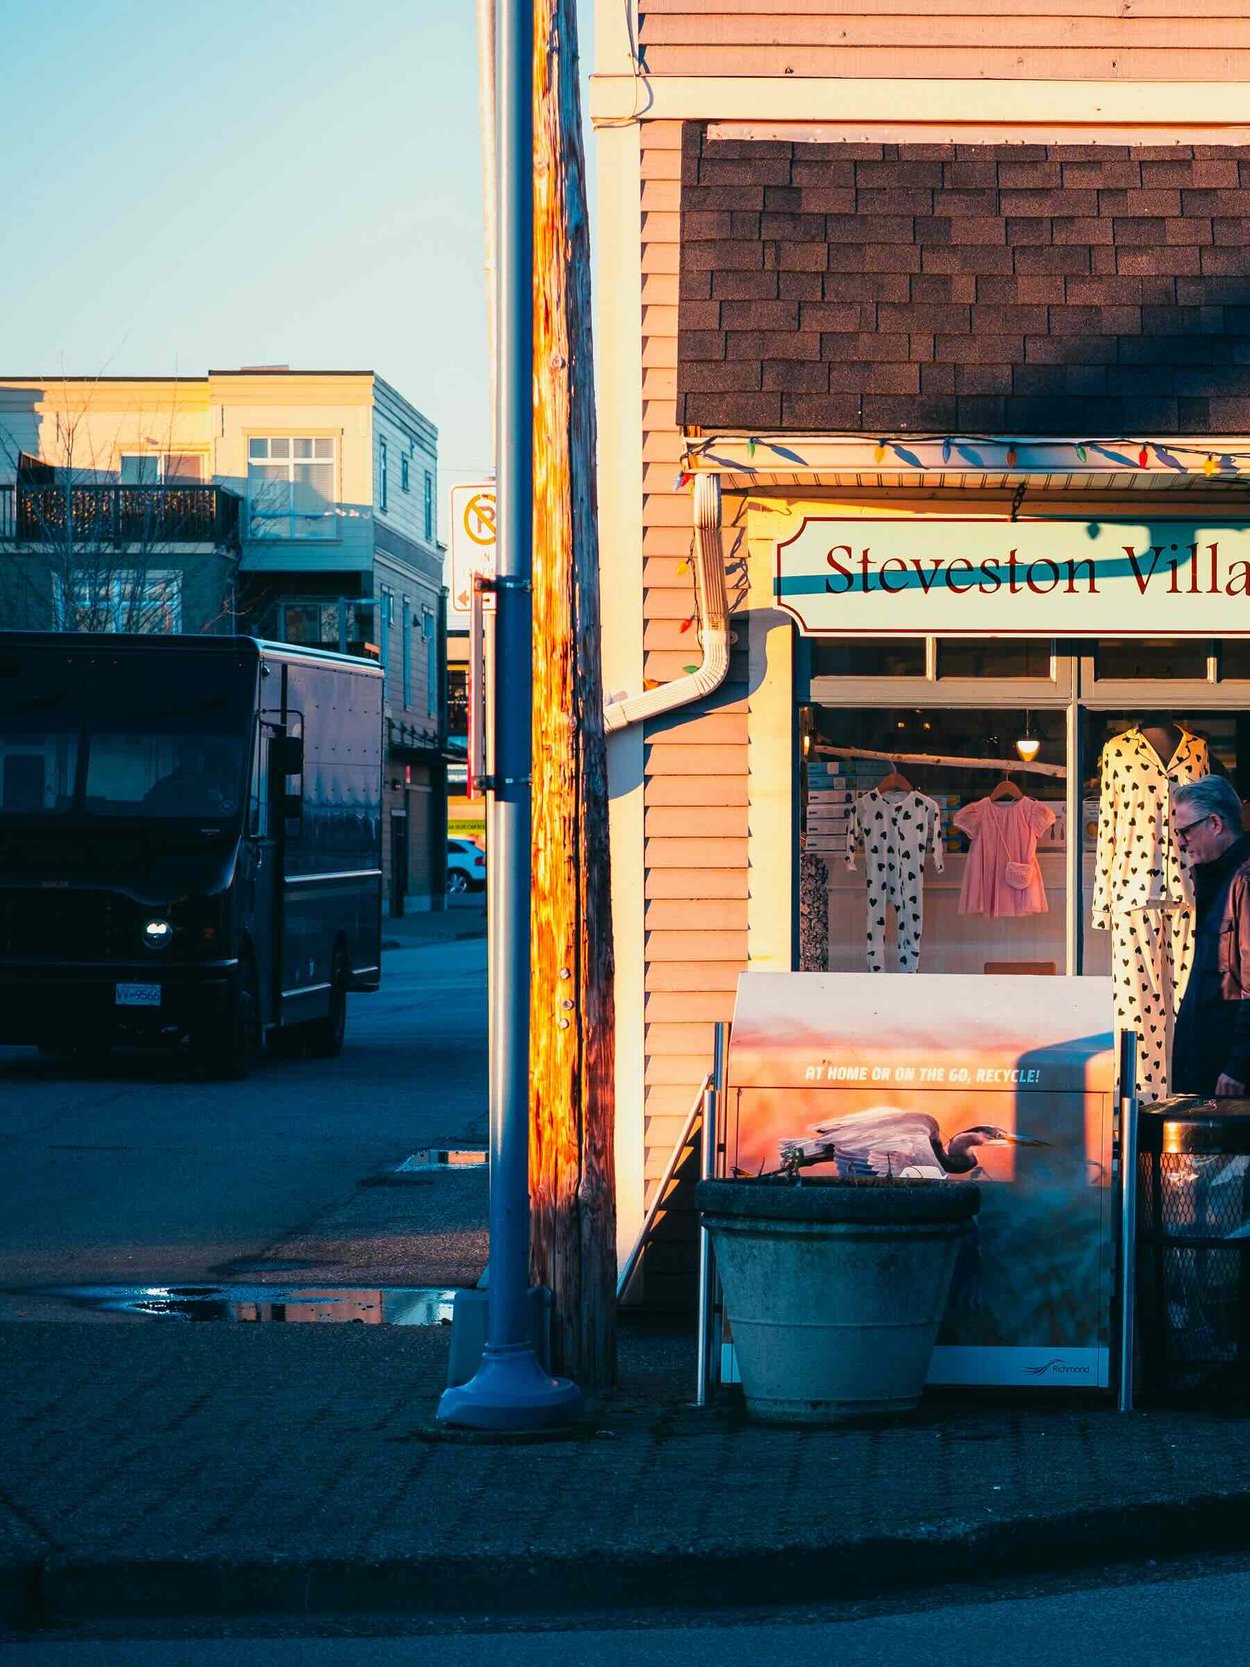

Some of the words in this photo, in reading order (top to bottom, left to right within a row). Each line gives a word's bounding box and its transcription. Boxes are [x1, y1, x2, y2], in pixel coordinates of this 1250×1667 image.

[825, 545, 1101, 595] Steveston
[805, 1066, 824, 1081] AT
[827, 1066, 867, 1081] HOME
[871, 1067, 891, 1081] OR
[895, 1067, 914, 1082] ON
[919, 1068, 945, 1082] THE
[948, 1068, 971, 1083] GO,
[976, 1068, 1041, 1083] RECYCLE!
[1052, 1365, 1090, 1373] Richmond
